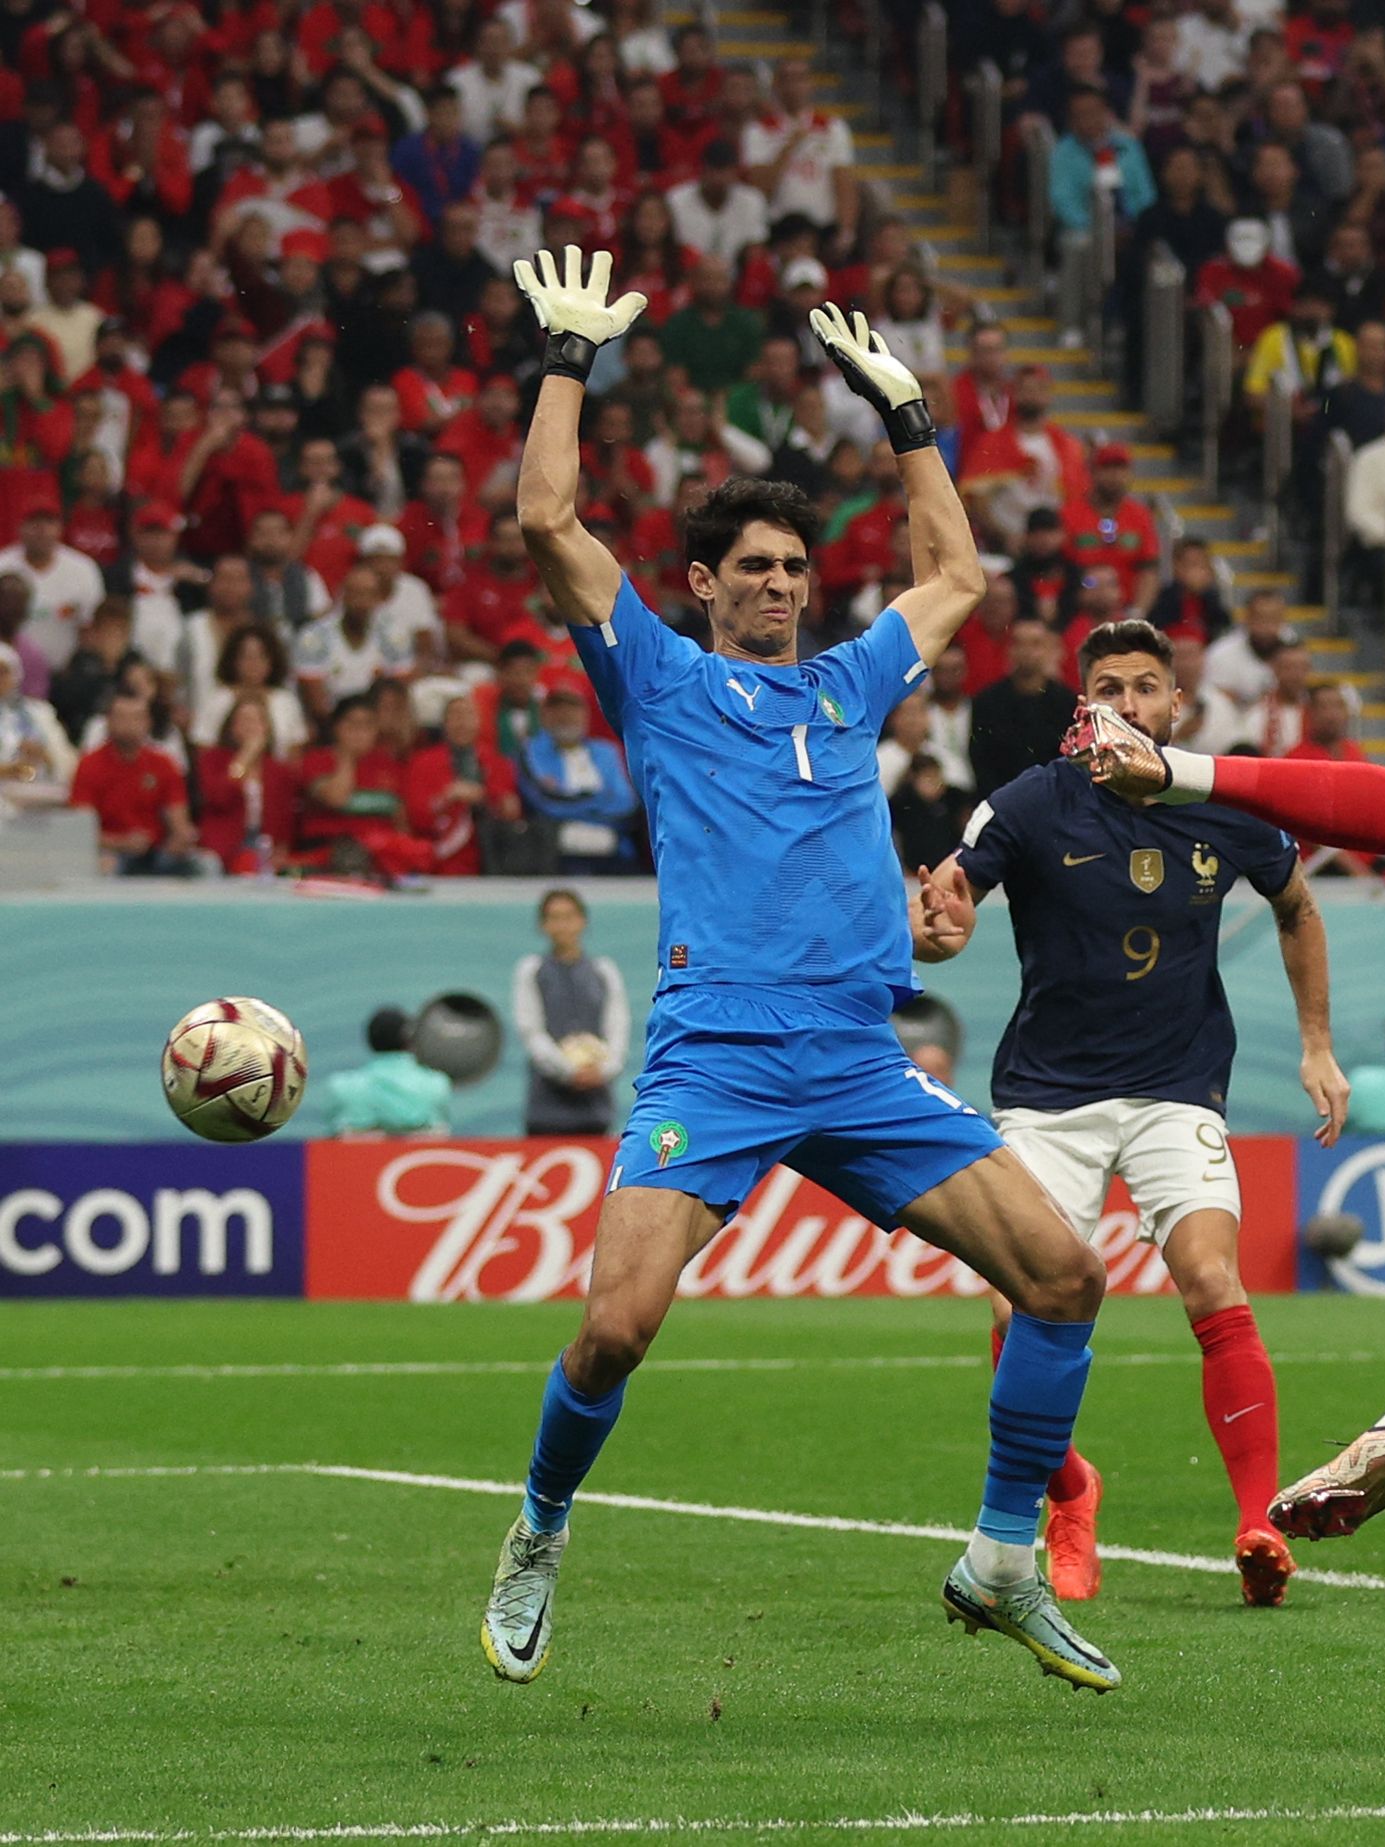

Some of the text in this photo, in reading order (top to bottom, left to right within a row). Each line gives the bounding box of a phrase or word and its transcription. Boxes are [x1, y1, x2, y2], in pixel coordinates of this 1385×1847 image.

[790, 723, 813, 782] 1
[1122, 925, 1160, 981] 9
[1195, 1122, 1228, 1165] 9
[0, 1187, 273, 1276] com
